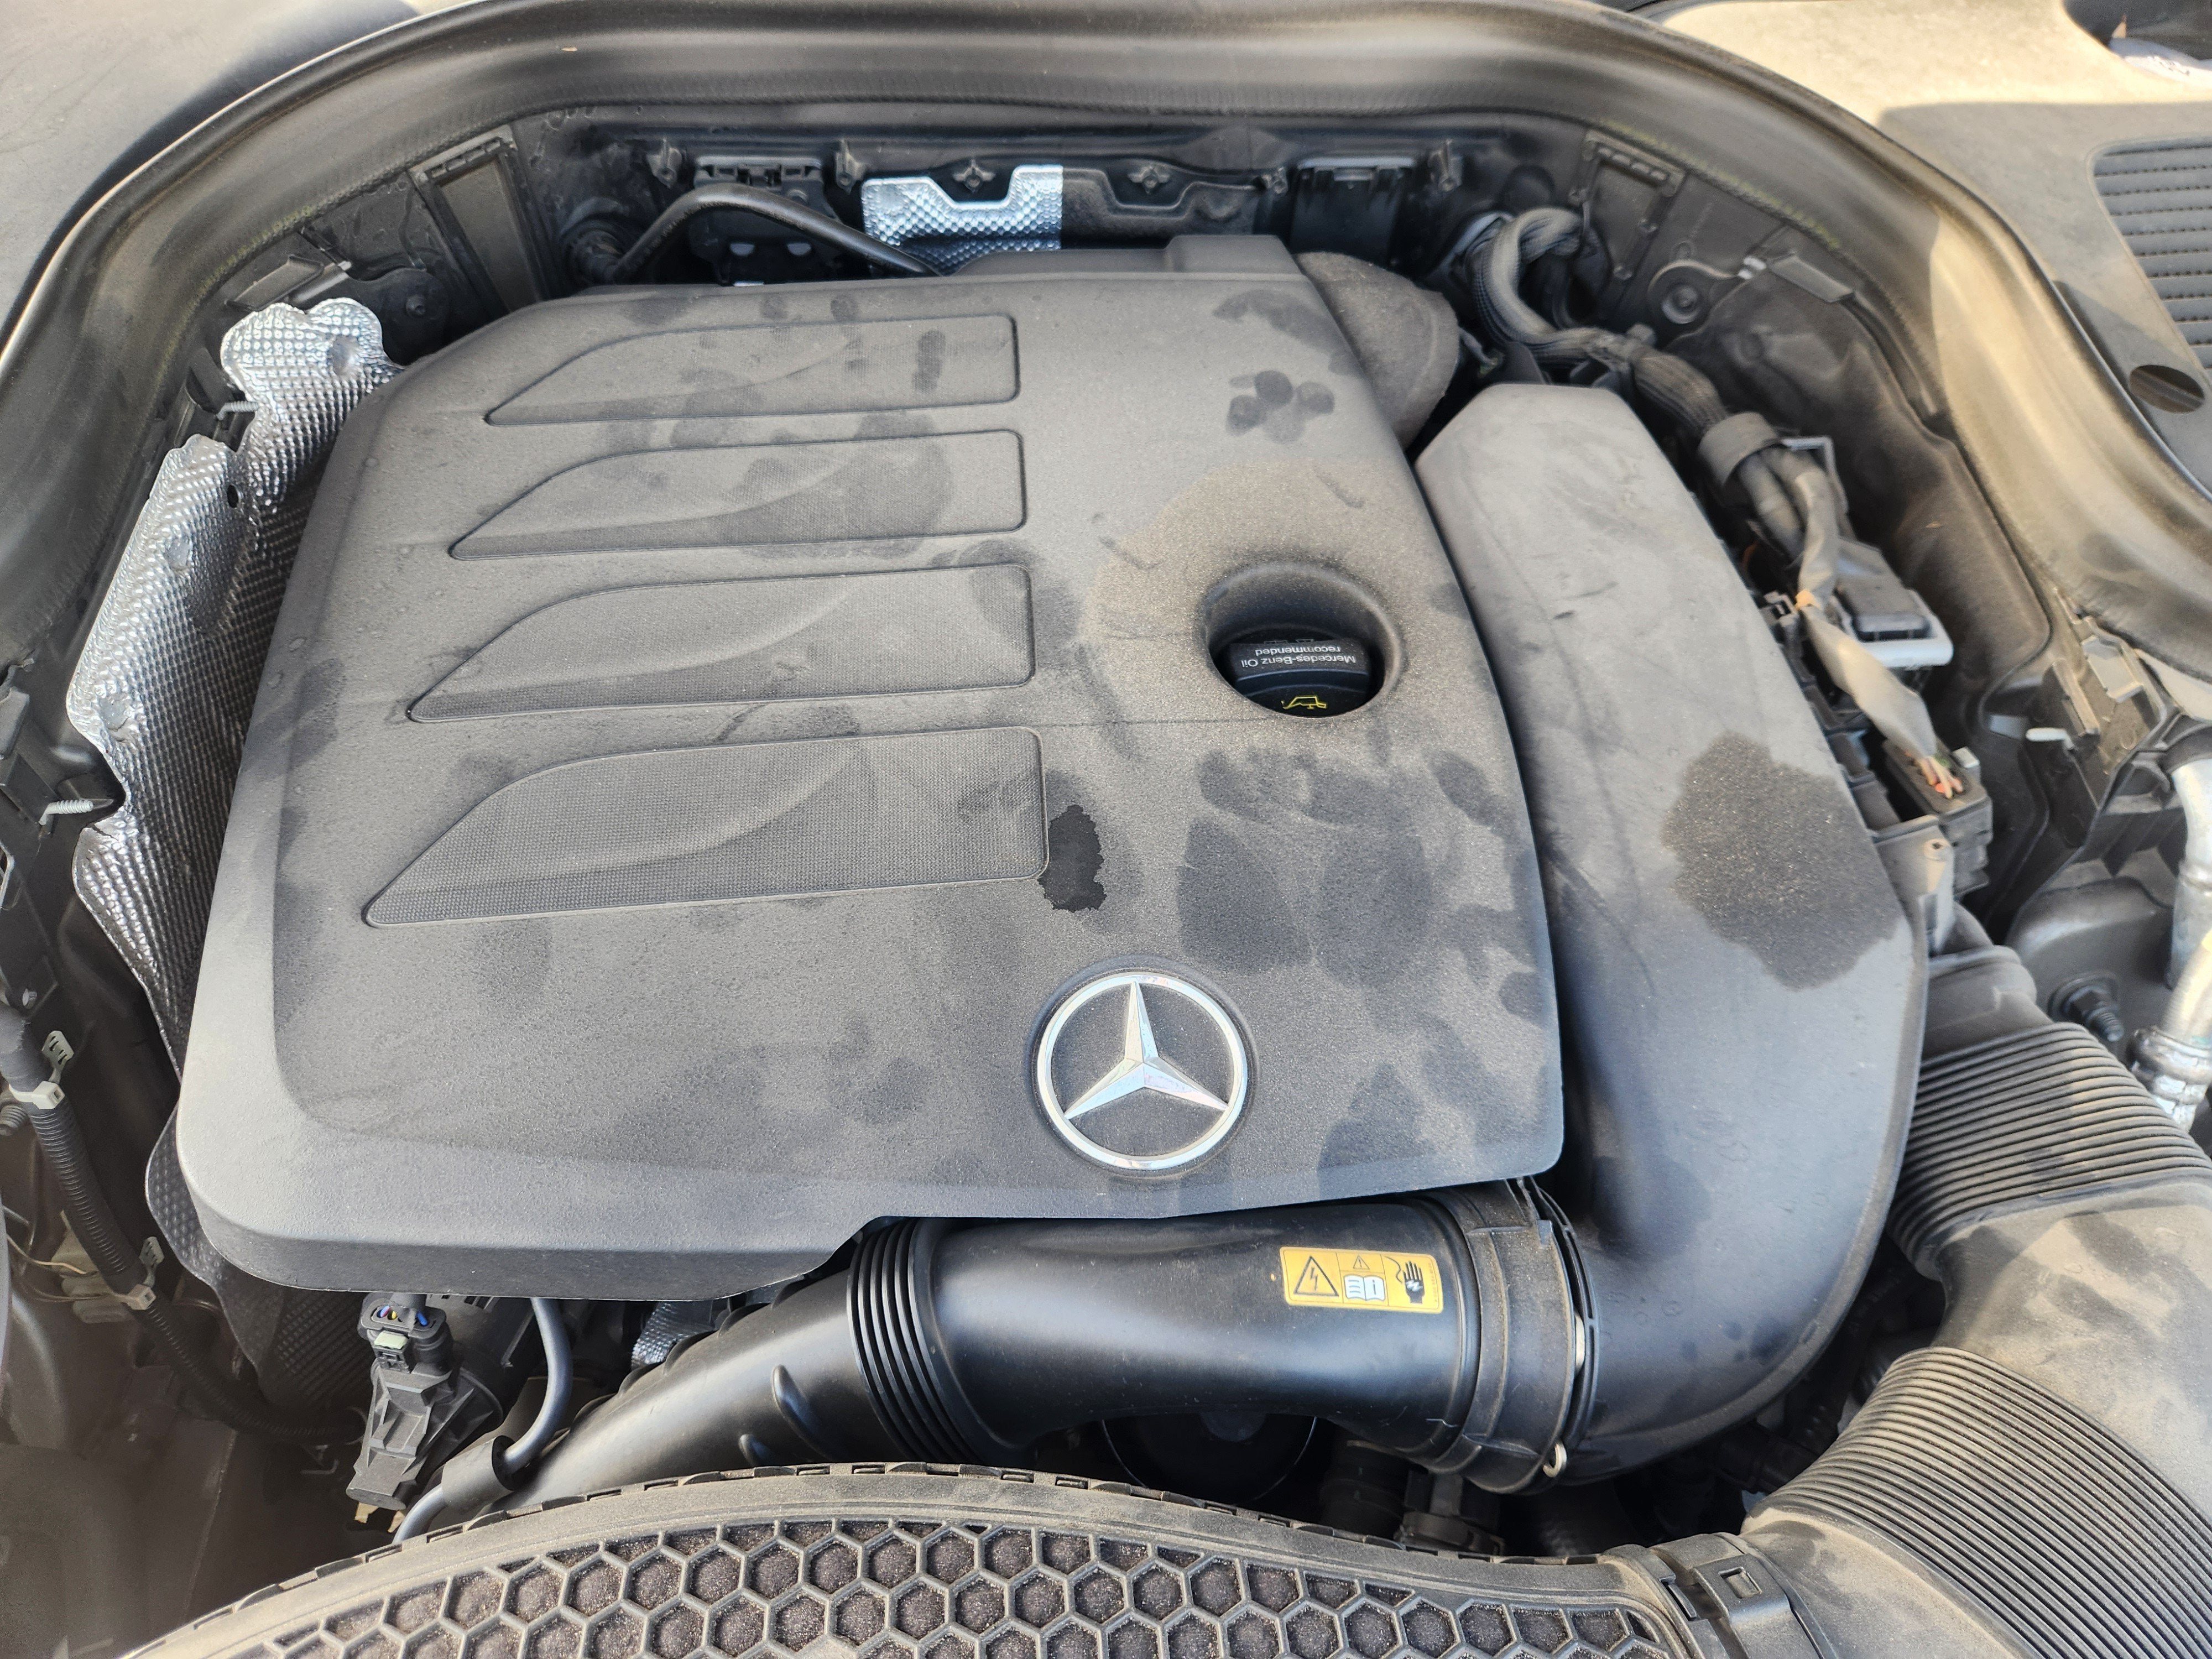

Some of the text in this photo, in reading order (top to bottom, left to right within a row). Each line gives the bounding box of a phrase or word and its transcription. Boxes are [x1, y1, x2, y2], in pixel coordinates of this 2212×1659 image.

[1255, 646, 1340, 656] recommended
[1241, 655, 1357, 667] Mercedes-Benz Oil
